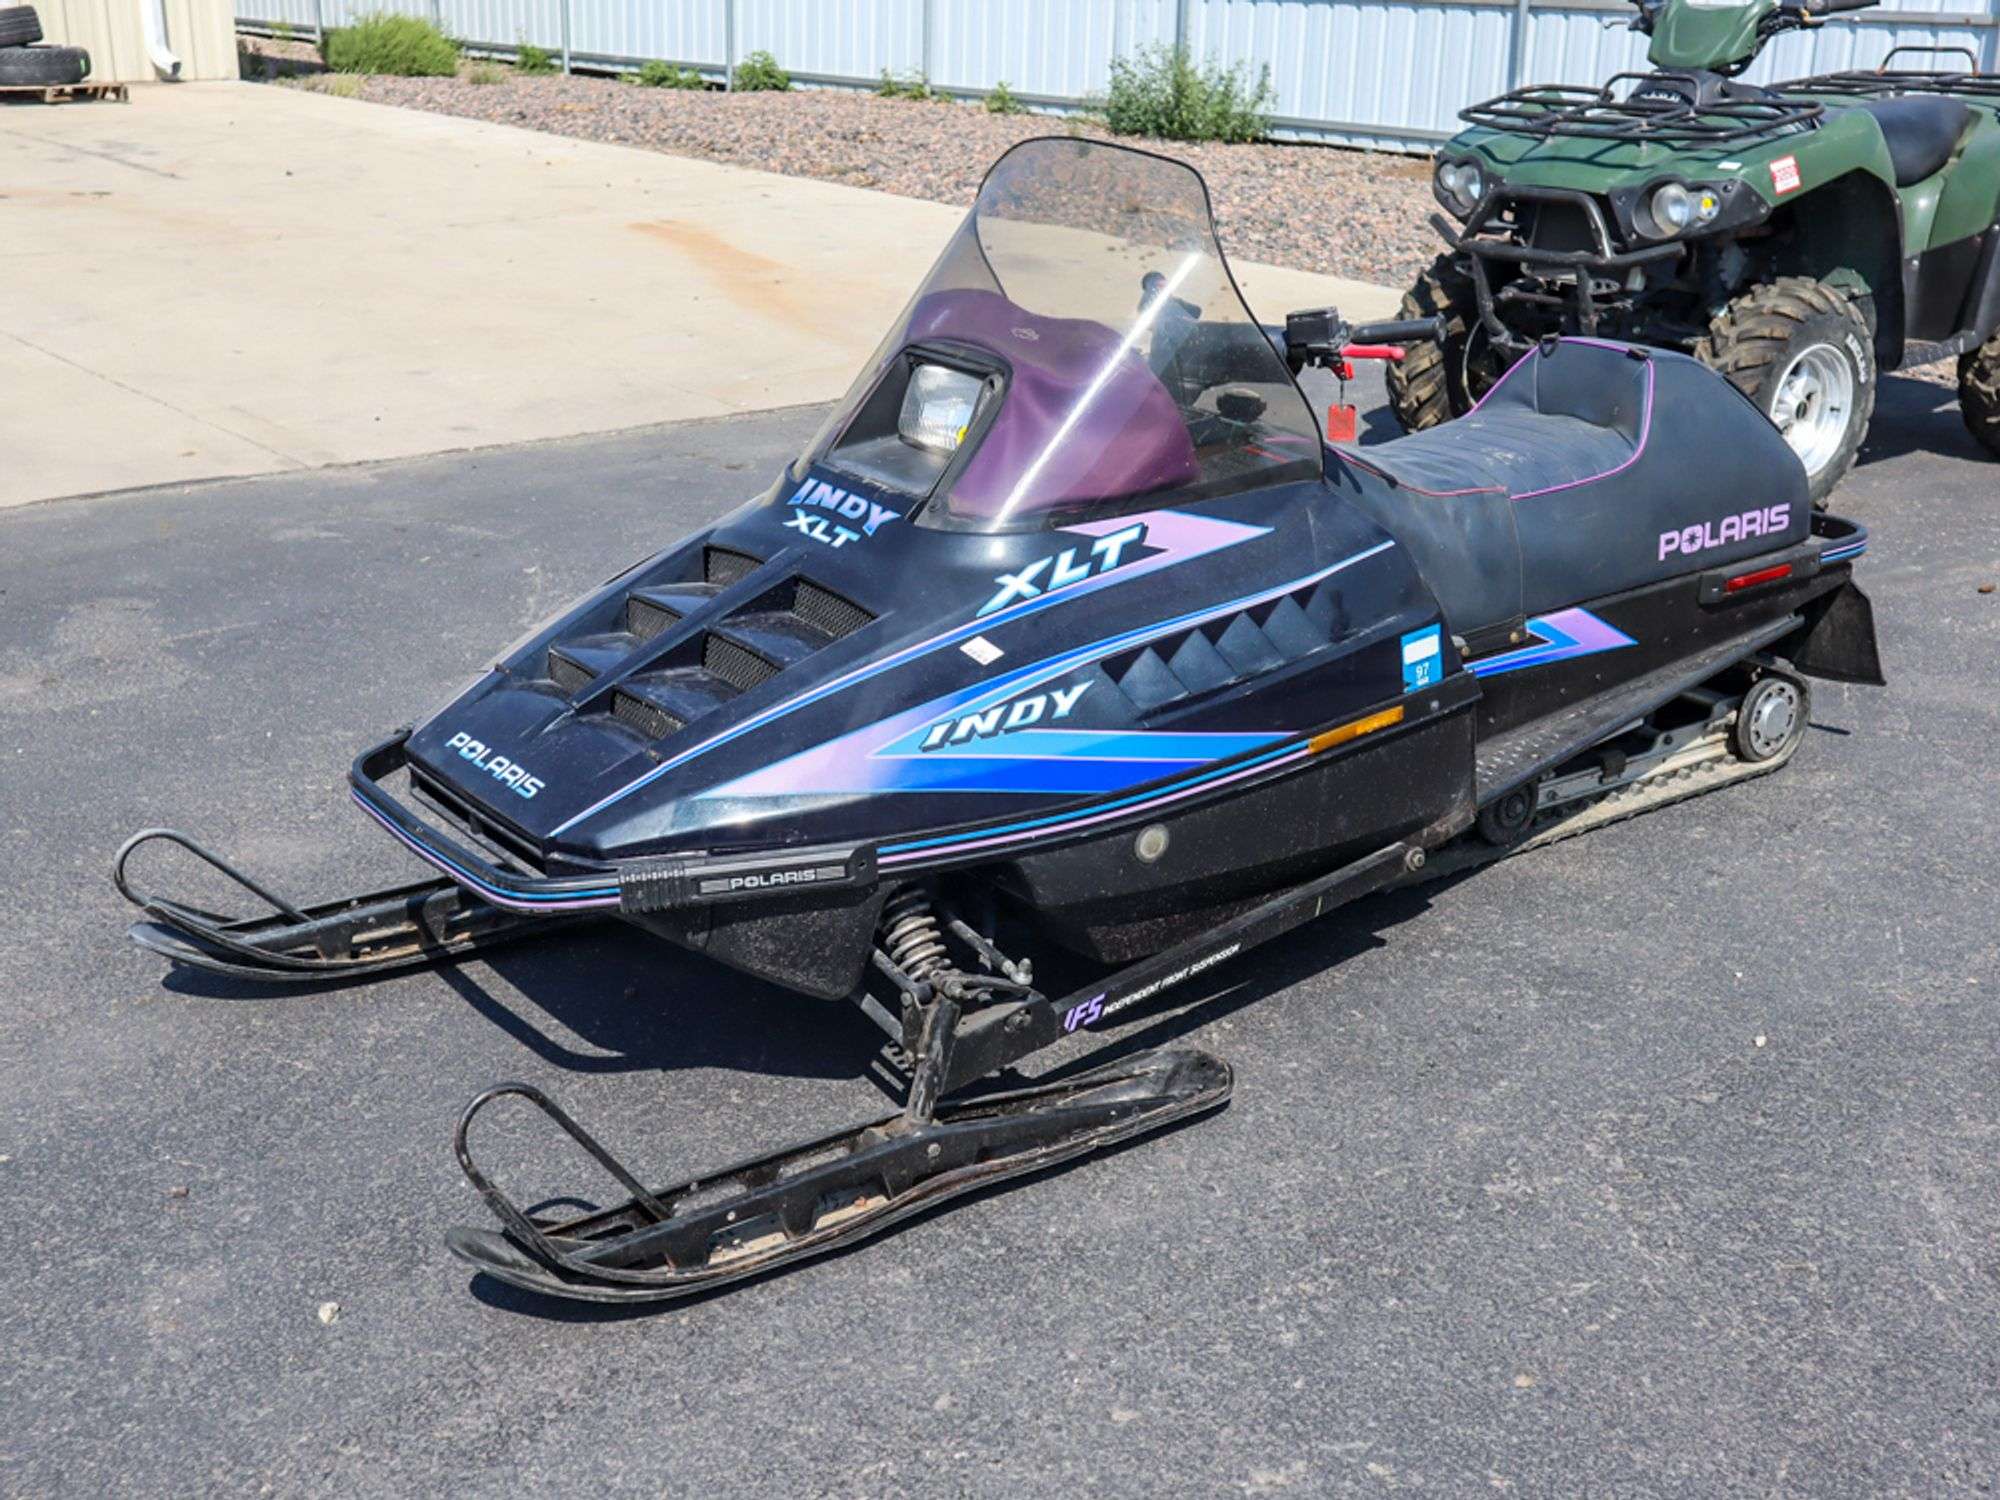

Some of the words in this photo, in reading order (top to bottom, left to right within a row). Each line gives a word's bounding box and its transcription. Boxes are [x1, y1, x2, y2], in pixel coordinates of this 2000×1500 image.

[782, 508, 861, 548] XLT
[787, 477, 901, 537] INDY
[1658, 502, 1791, 561] POLARIS
[975, 523, 1145, 618] XLT
[919, 680, 1095, 752] INDY
[444, 731, 546, 799] POLARIS
[730, 868, 817, 890] POLARIS
[1064, 992, 1107, 1032] IFS
